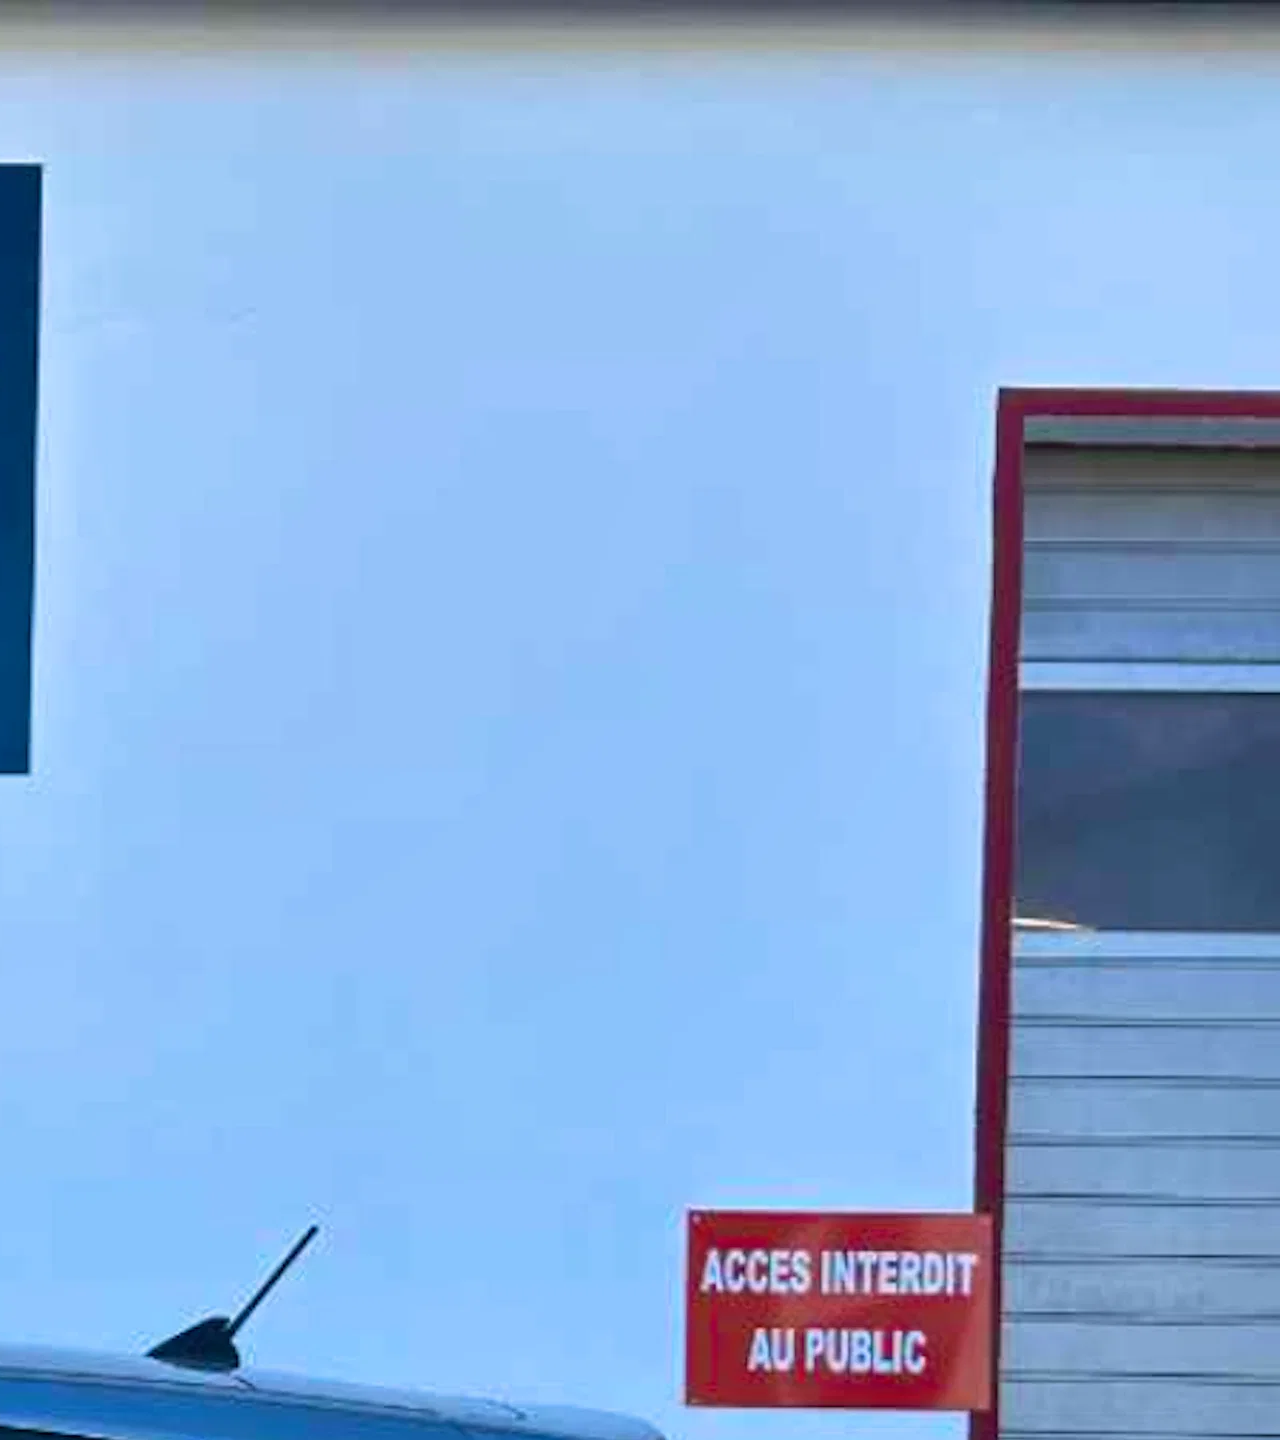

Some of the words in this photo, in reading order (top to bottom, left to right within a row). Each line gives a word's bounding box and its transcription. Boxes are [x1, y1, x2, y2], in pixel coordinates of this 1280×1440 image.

[701, 1249, 812, 1294] ACCES
[821, 1251, 979, 1294] INTERDIT
[749, 1328, 794, 1371] AU
[806, 1329, 925, 1373] PUBLIC
